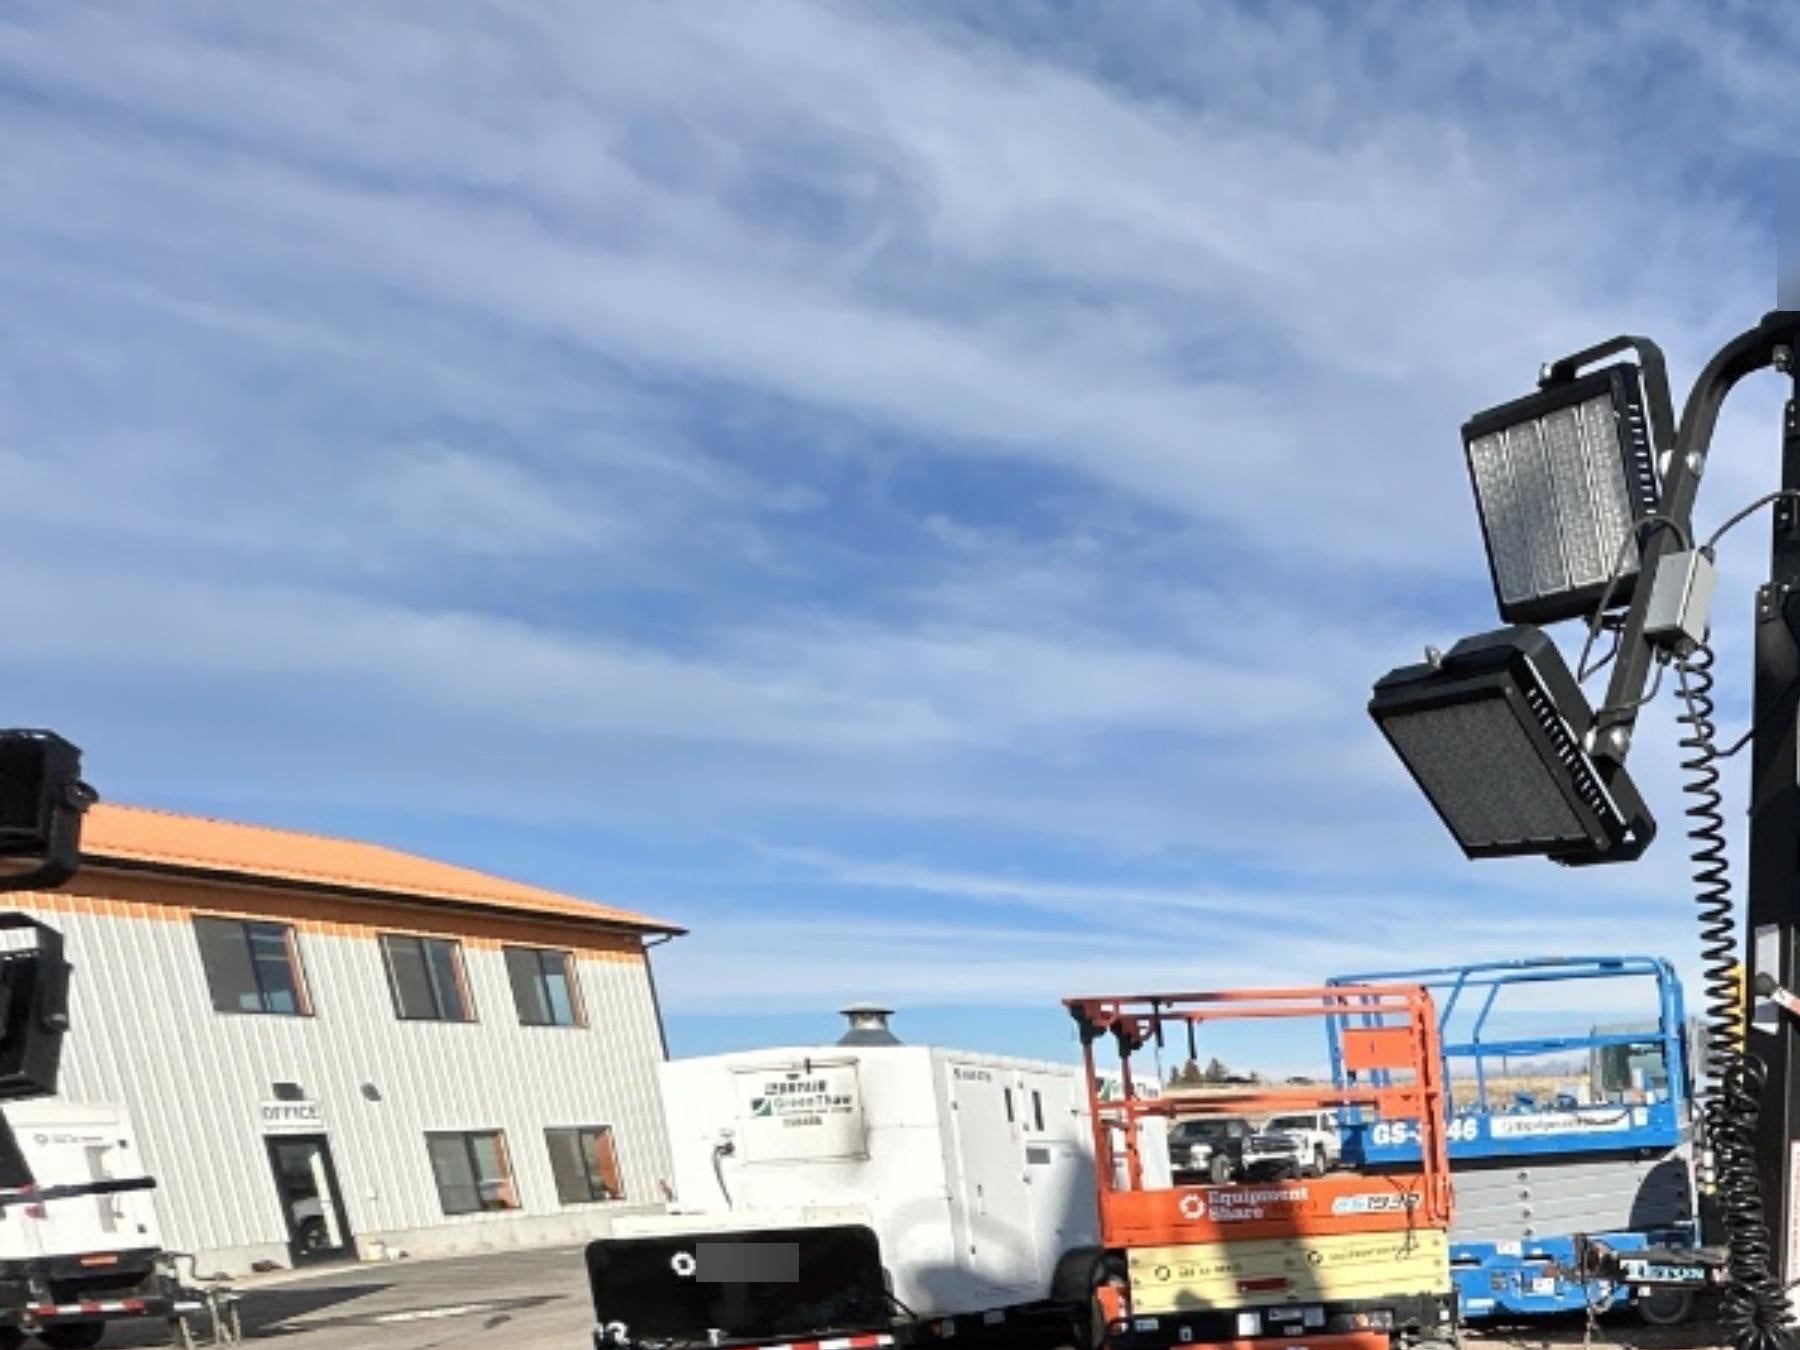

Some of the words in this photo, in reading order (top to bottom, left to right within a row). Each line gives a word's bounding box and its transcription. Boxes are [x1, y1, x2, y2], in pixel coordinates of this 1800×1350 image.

[1373, 1117, 1478, 1145] GS-46
[1207, 1187, 1309, 1208] Equipment
[1208, 1204, 1264, 1221] Share
